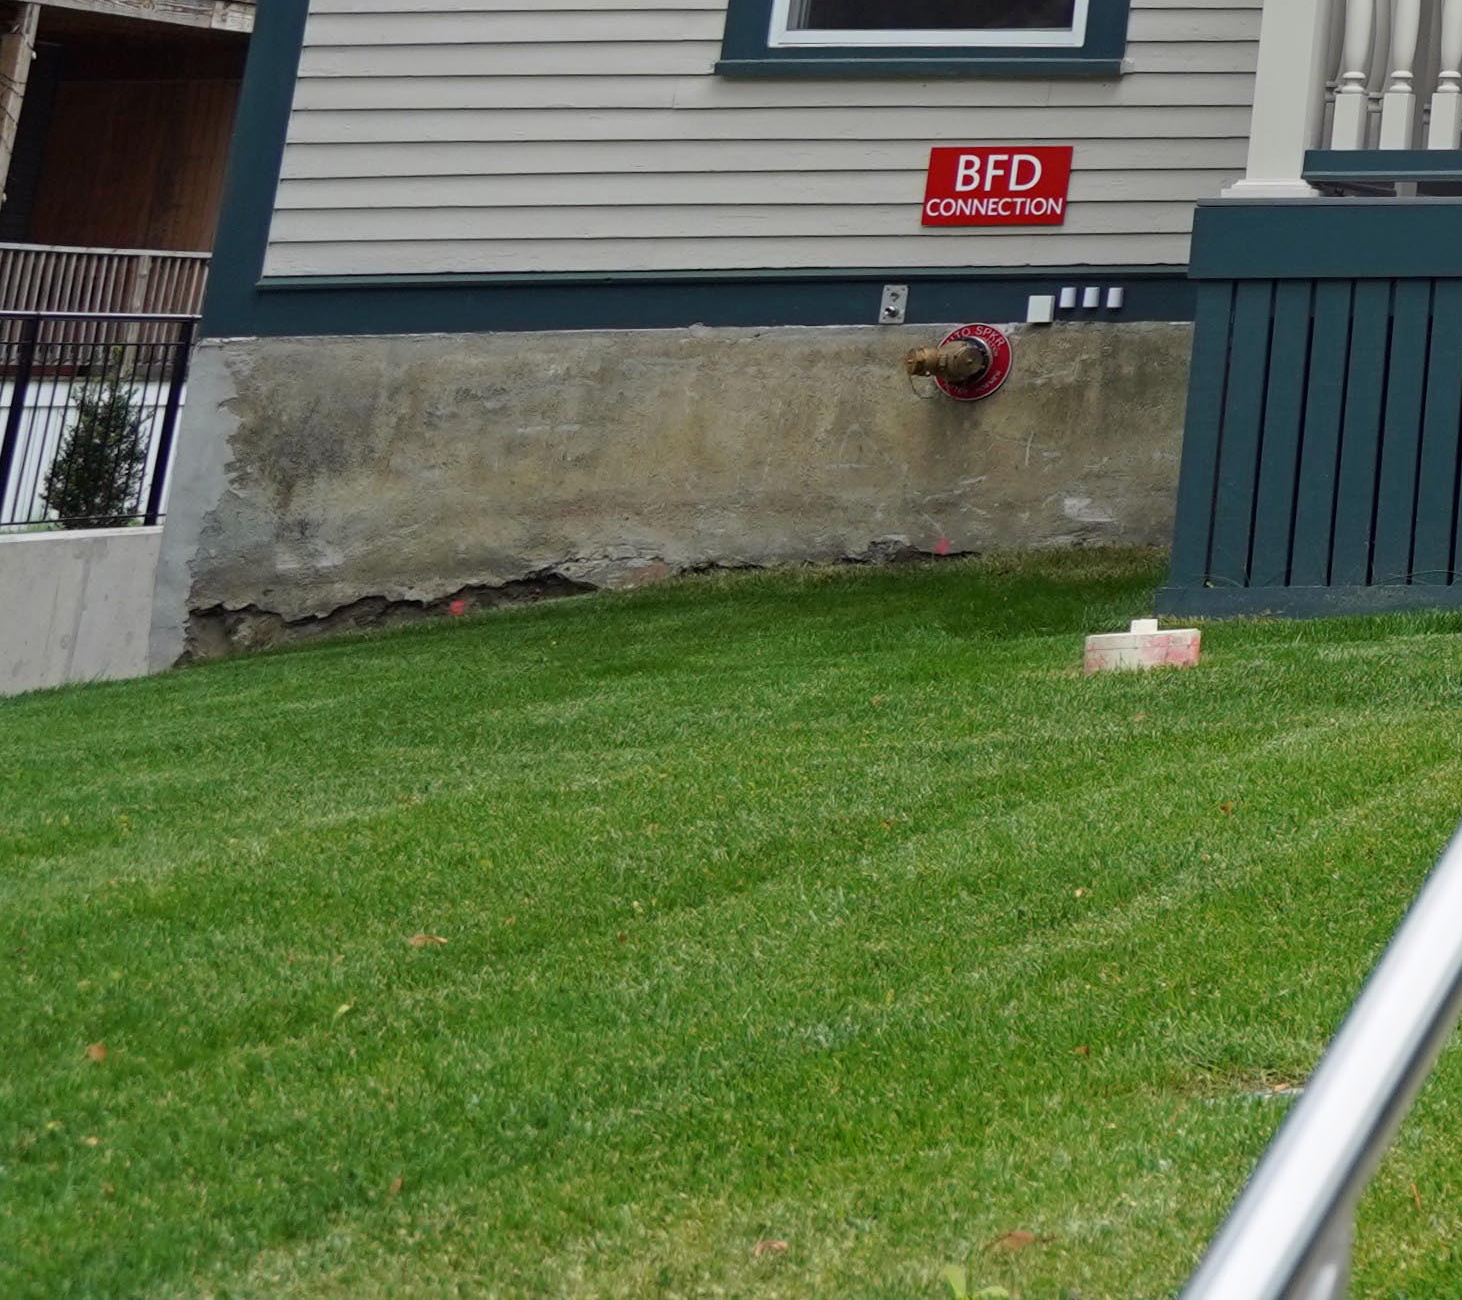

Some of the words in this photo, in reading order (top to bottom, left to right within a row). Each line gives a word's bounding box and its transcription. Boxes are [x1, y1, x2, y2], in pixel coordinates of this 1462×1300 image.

[955, 153, 1042, 192] BFD
[926, 197, 1063, 216] CONNECTION
[975, 325, 1006, 347] SPKR
